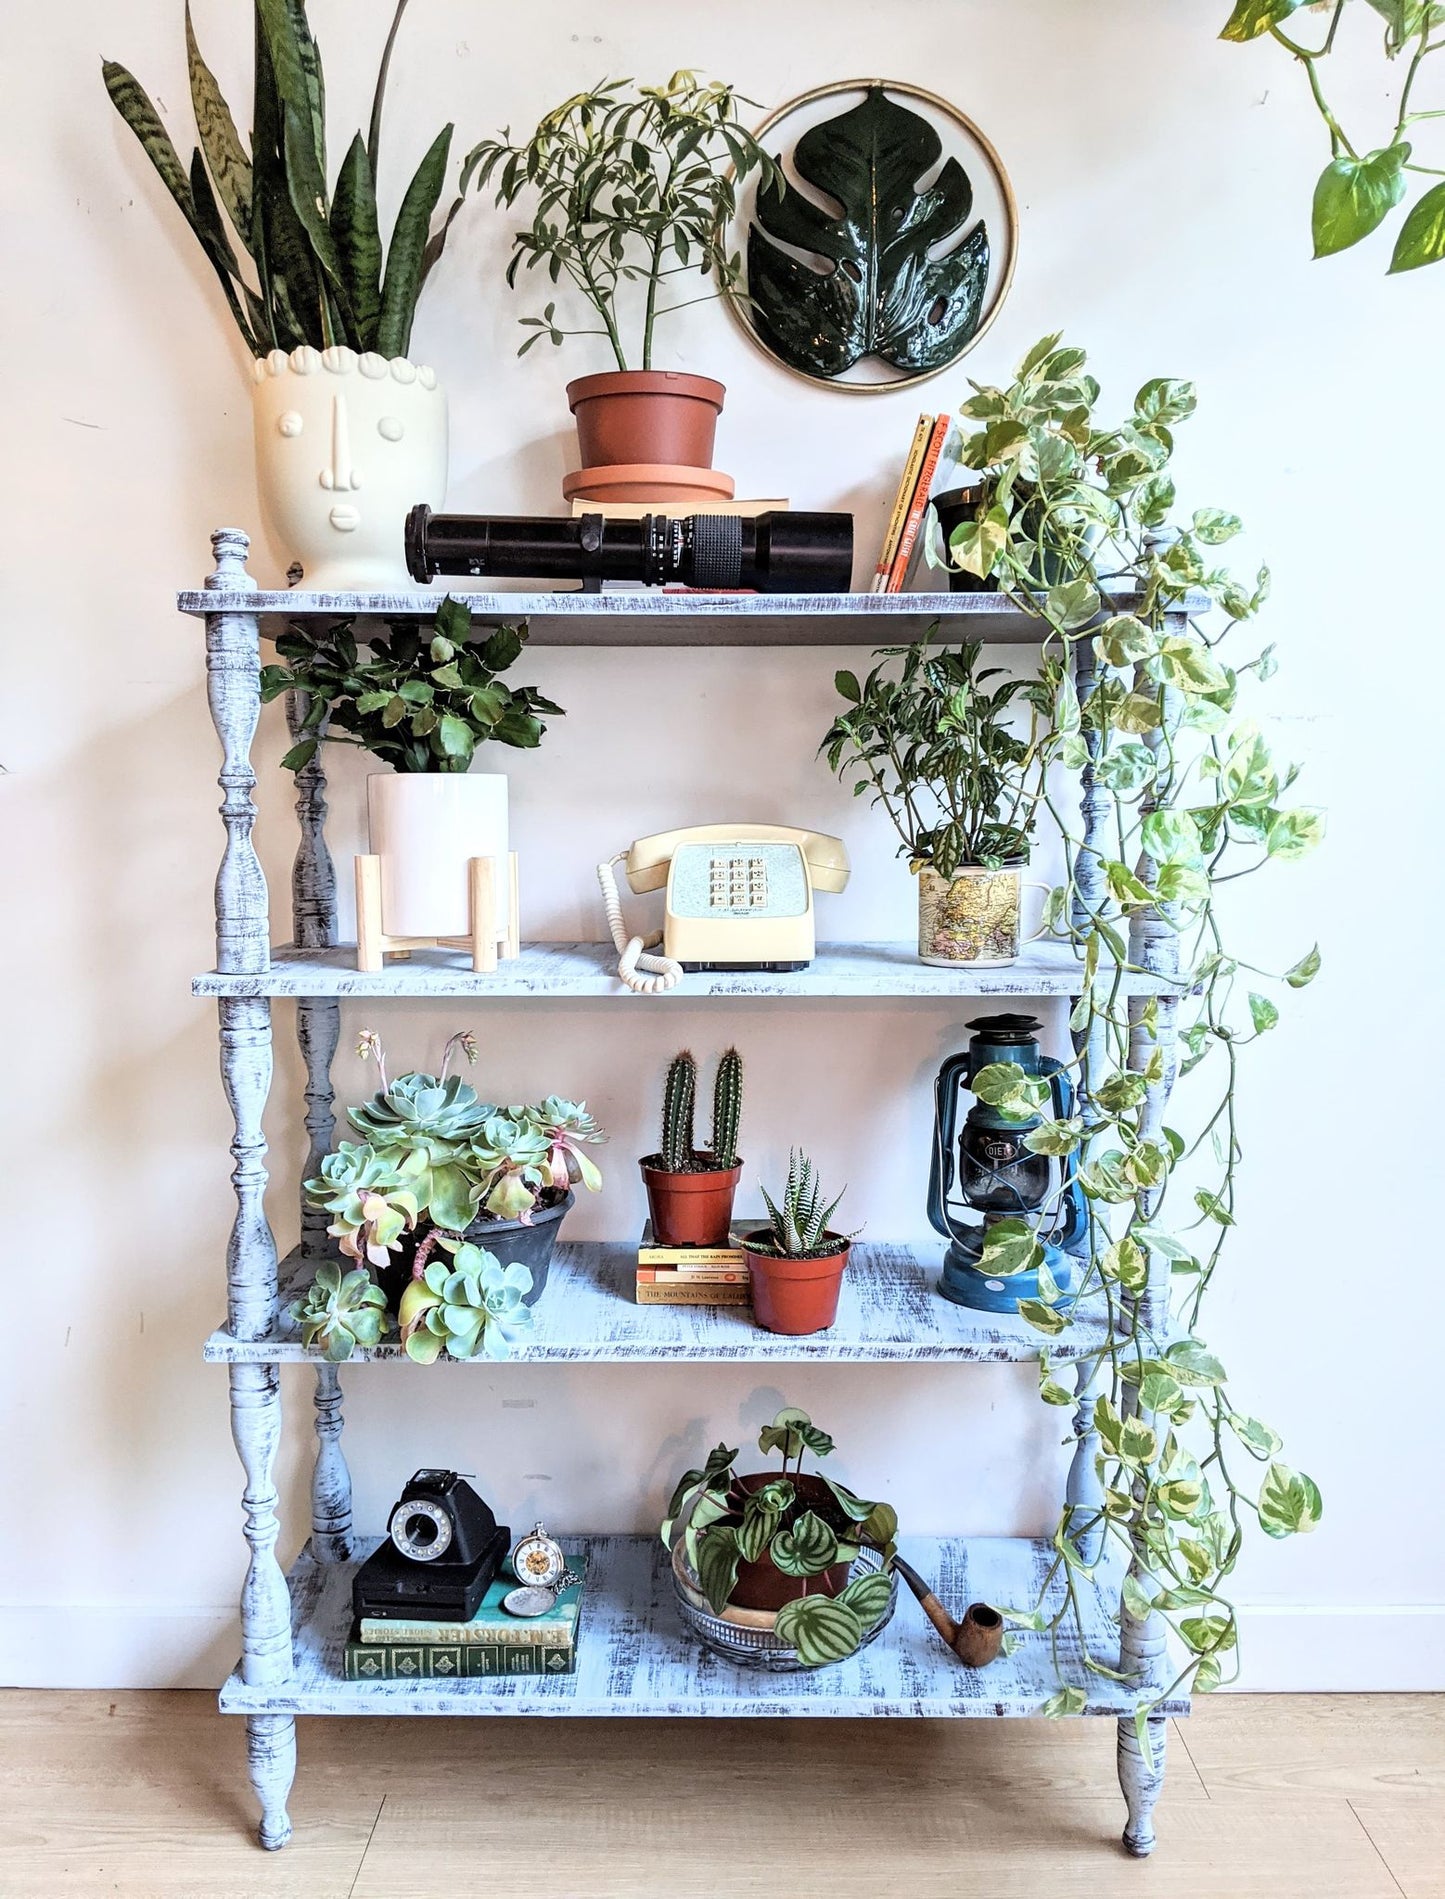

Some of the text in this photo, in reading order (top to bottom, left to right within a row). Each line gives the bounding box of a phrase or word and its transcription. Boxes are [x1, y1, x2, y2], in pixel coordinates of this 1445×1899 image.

[929, 429, 946, 459] SCOTT
[914, 459, 937, 509] FITZGERALD
[899, 536, 913, 558] GATSBY
[664, 1291, 708, 1299] MOUNTAINS
